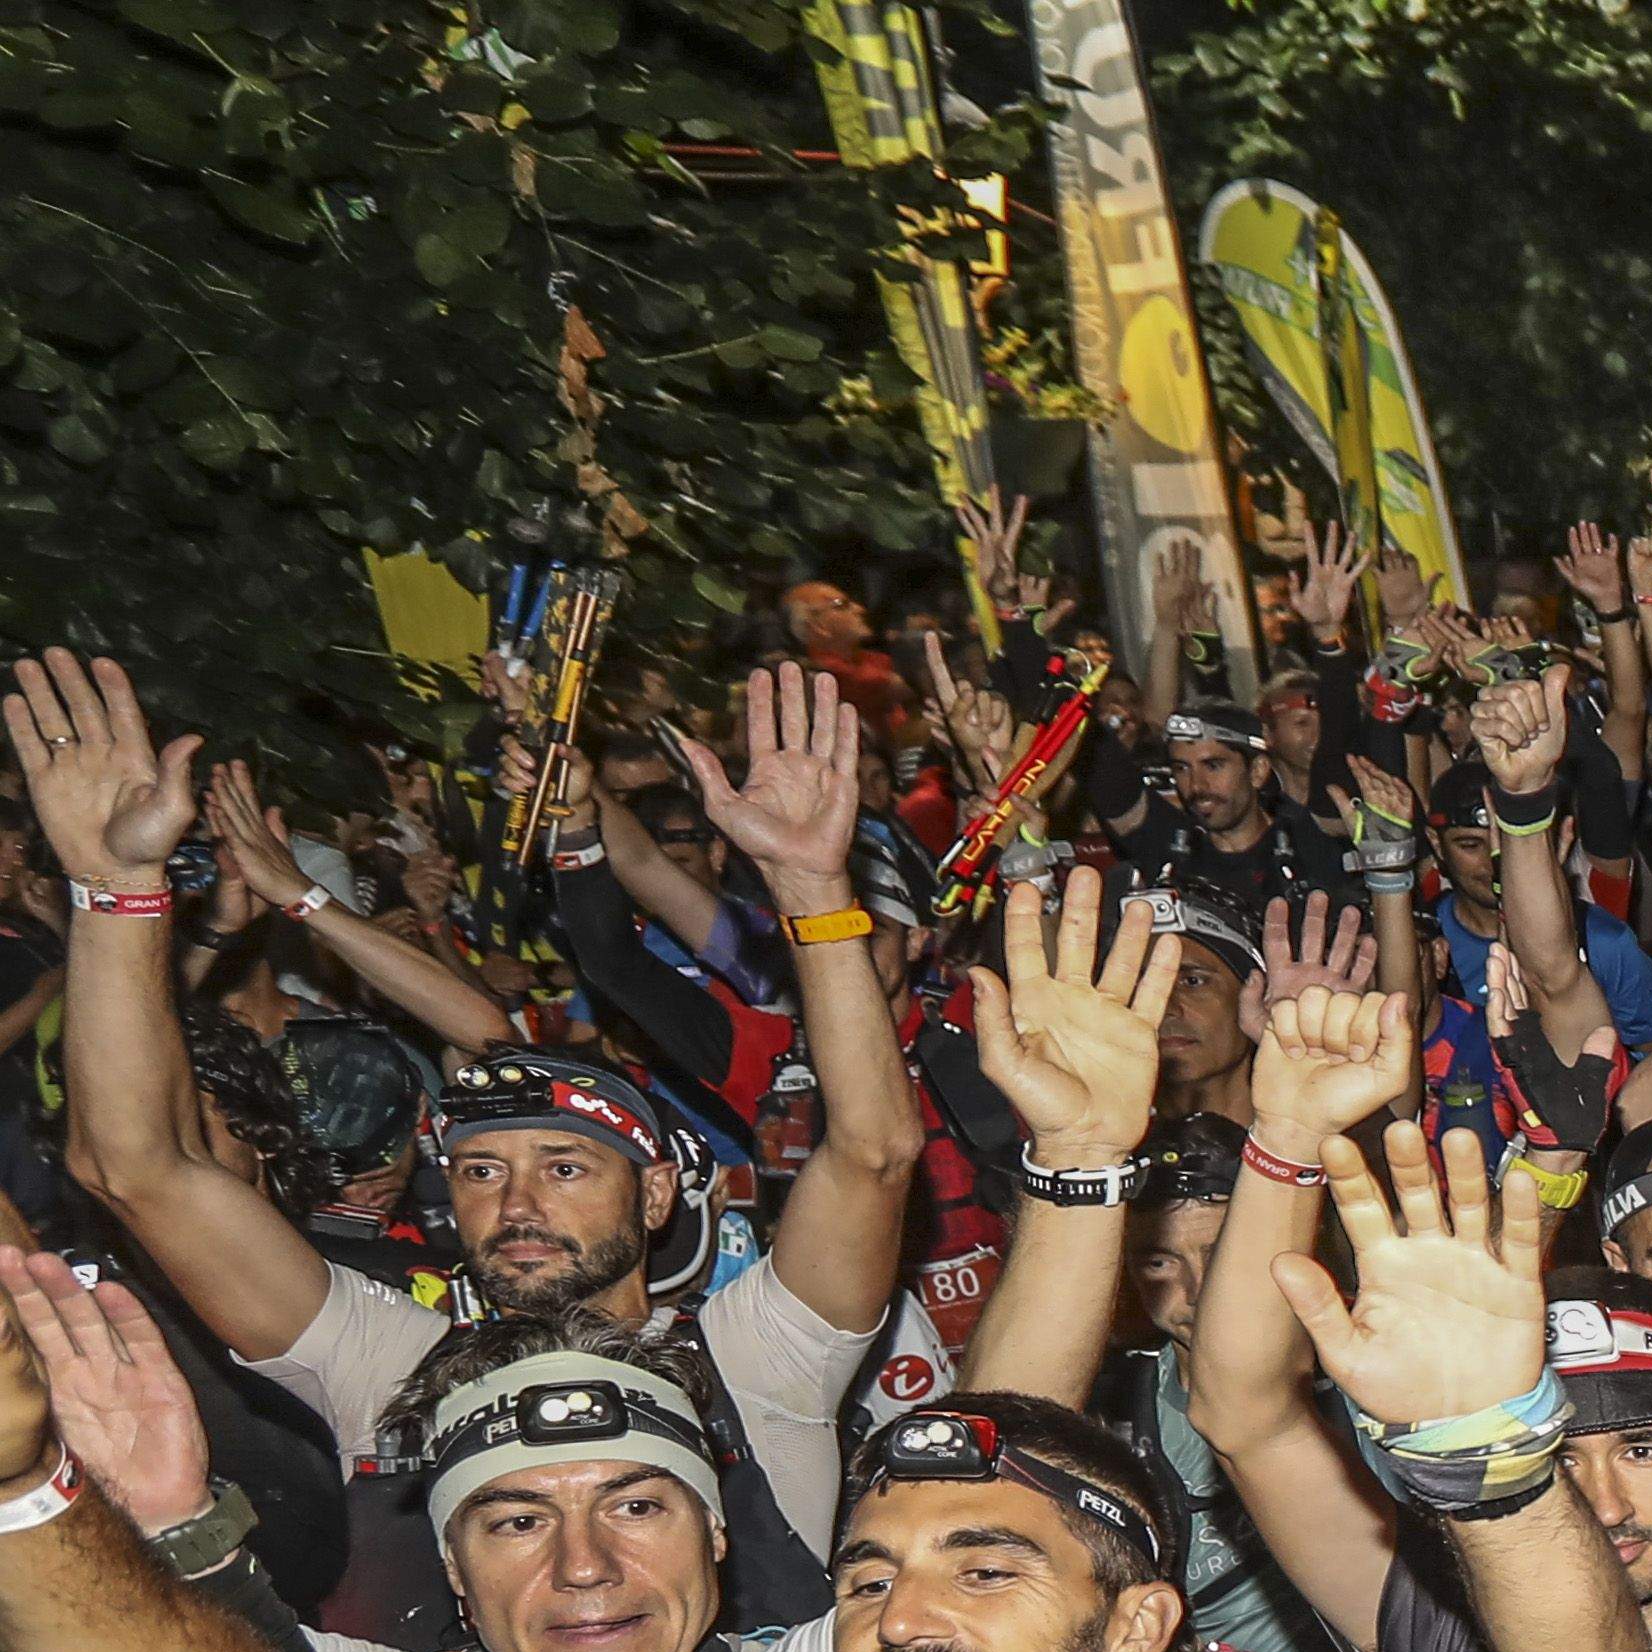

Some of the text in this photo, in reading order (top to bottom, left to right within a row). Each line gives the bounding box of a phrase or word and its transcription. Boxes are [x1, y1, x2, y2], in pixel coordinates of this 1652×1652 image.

[123, 898, 162, 910] GRAN
[1602, 1183, 1648, 1234] ILVA
[485, 1417, 517, 1444] PET
[1078, 1489, 1127, 1528] PETZL
